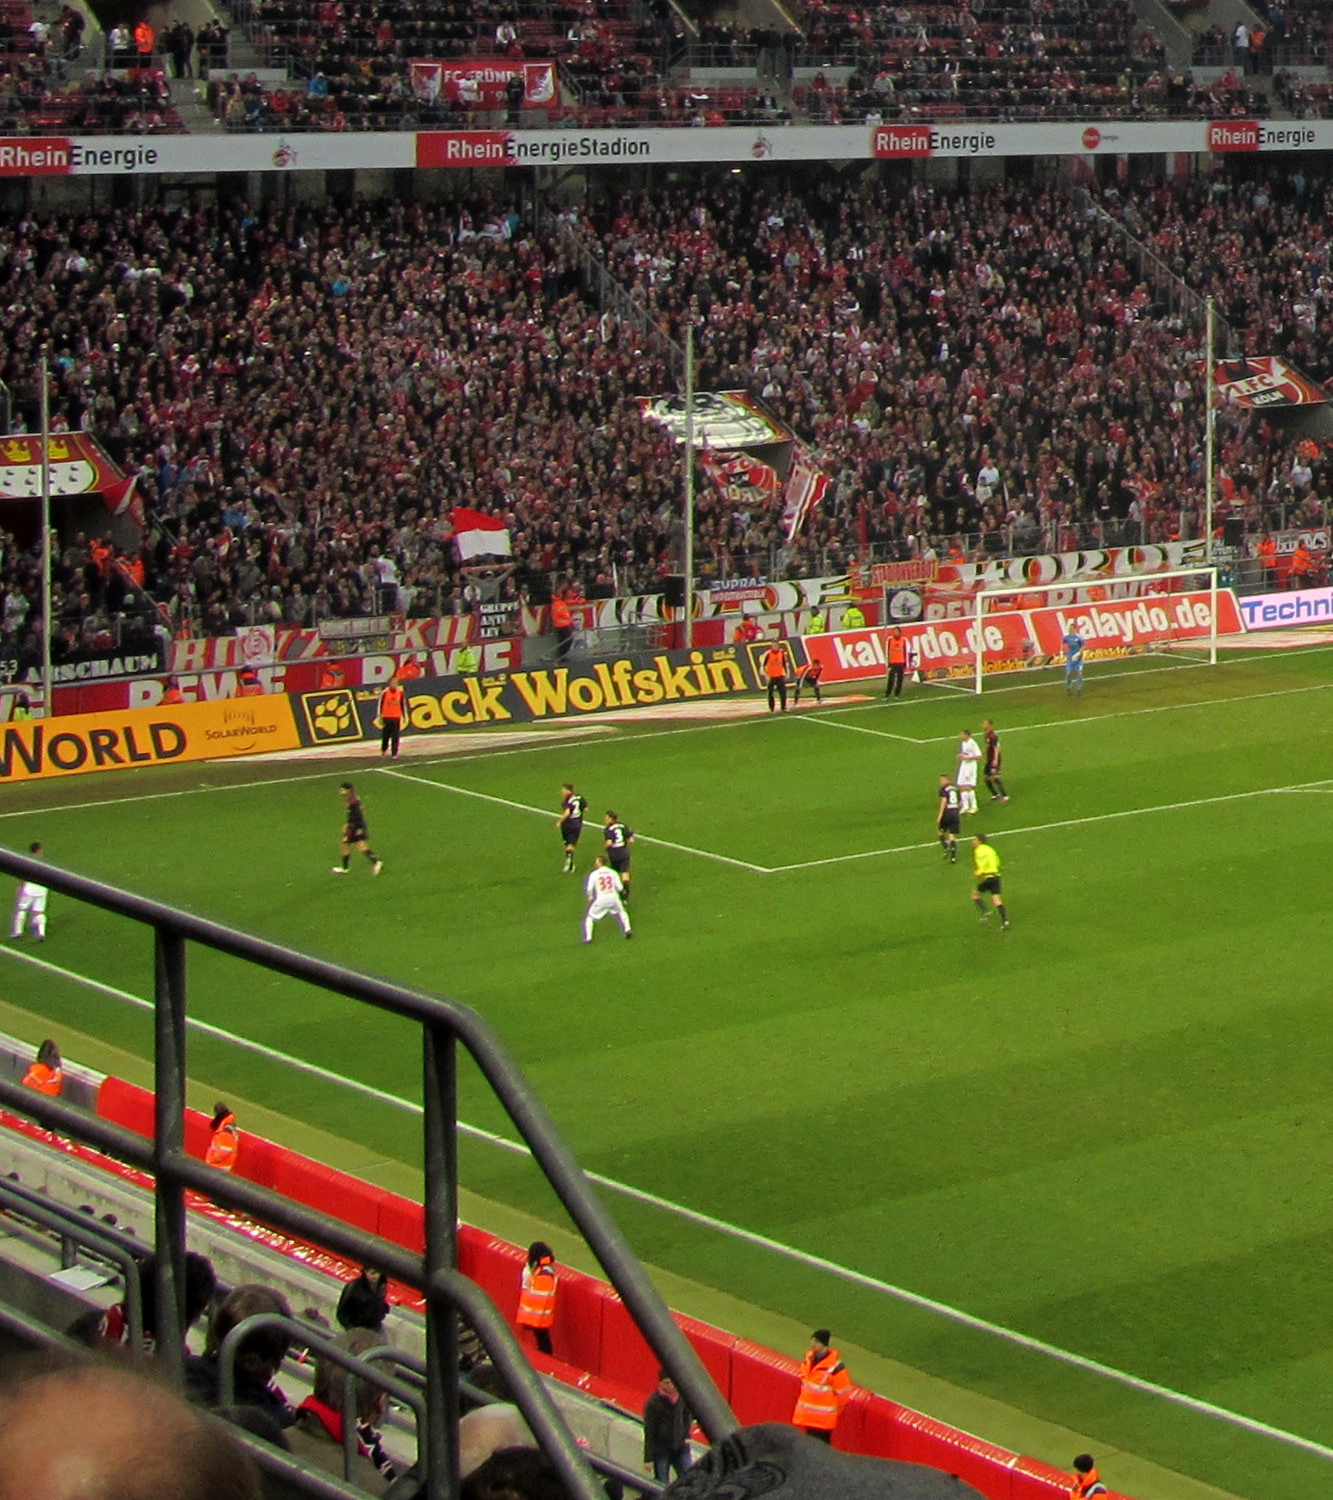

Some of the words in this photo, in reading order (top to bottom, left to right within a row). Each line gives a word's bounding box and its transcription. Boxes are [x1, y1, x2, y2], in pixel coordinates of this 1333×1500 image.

[877, 129, 996, 155] RheinEnergie
[1210, 124, 1316, 149] RheinEnergie
[0, 145, 158, 170] RheinEnergie
[446, 136, 650, 164] RheinEnergieStadion
[710, 575, 768, 590] SUPRAS
[1056, 597, 1212, 644] kalaydo.de
[510, 651, 749, 717] Wolfskin
[599, 875, 615, 892] 33
